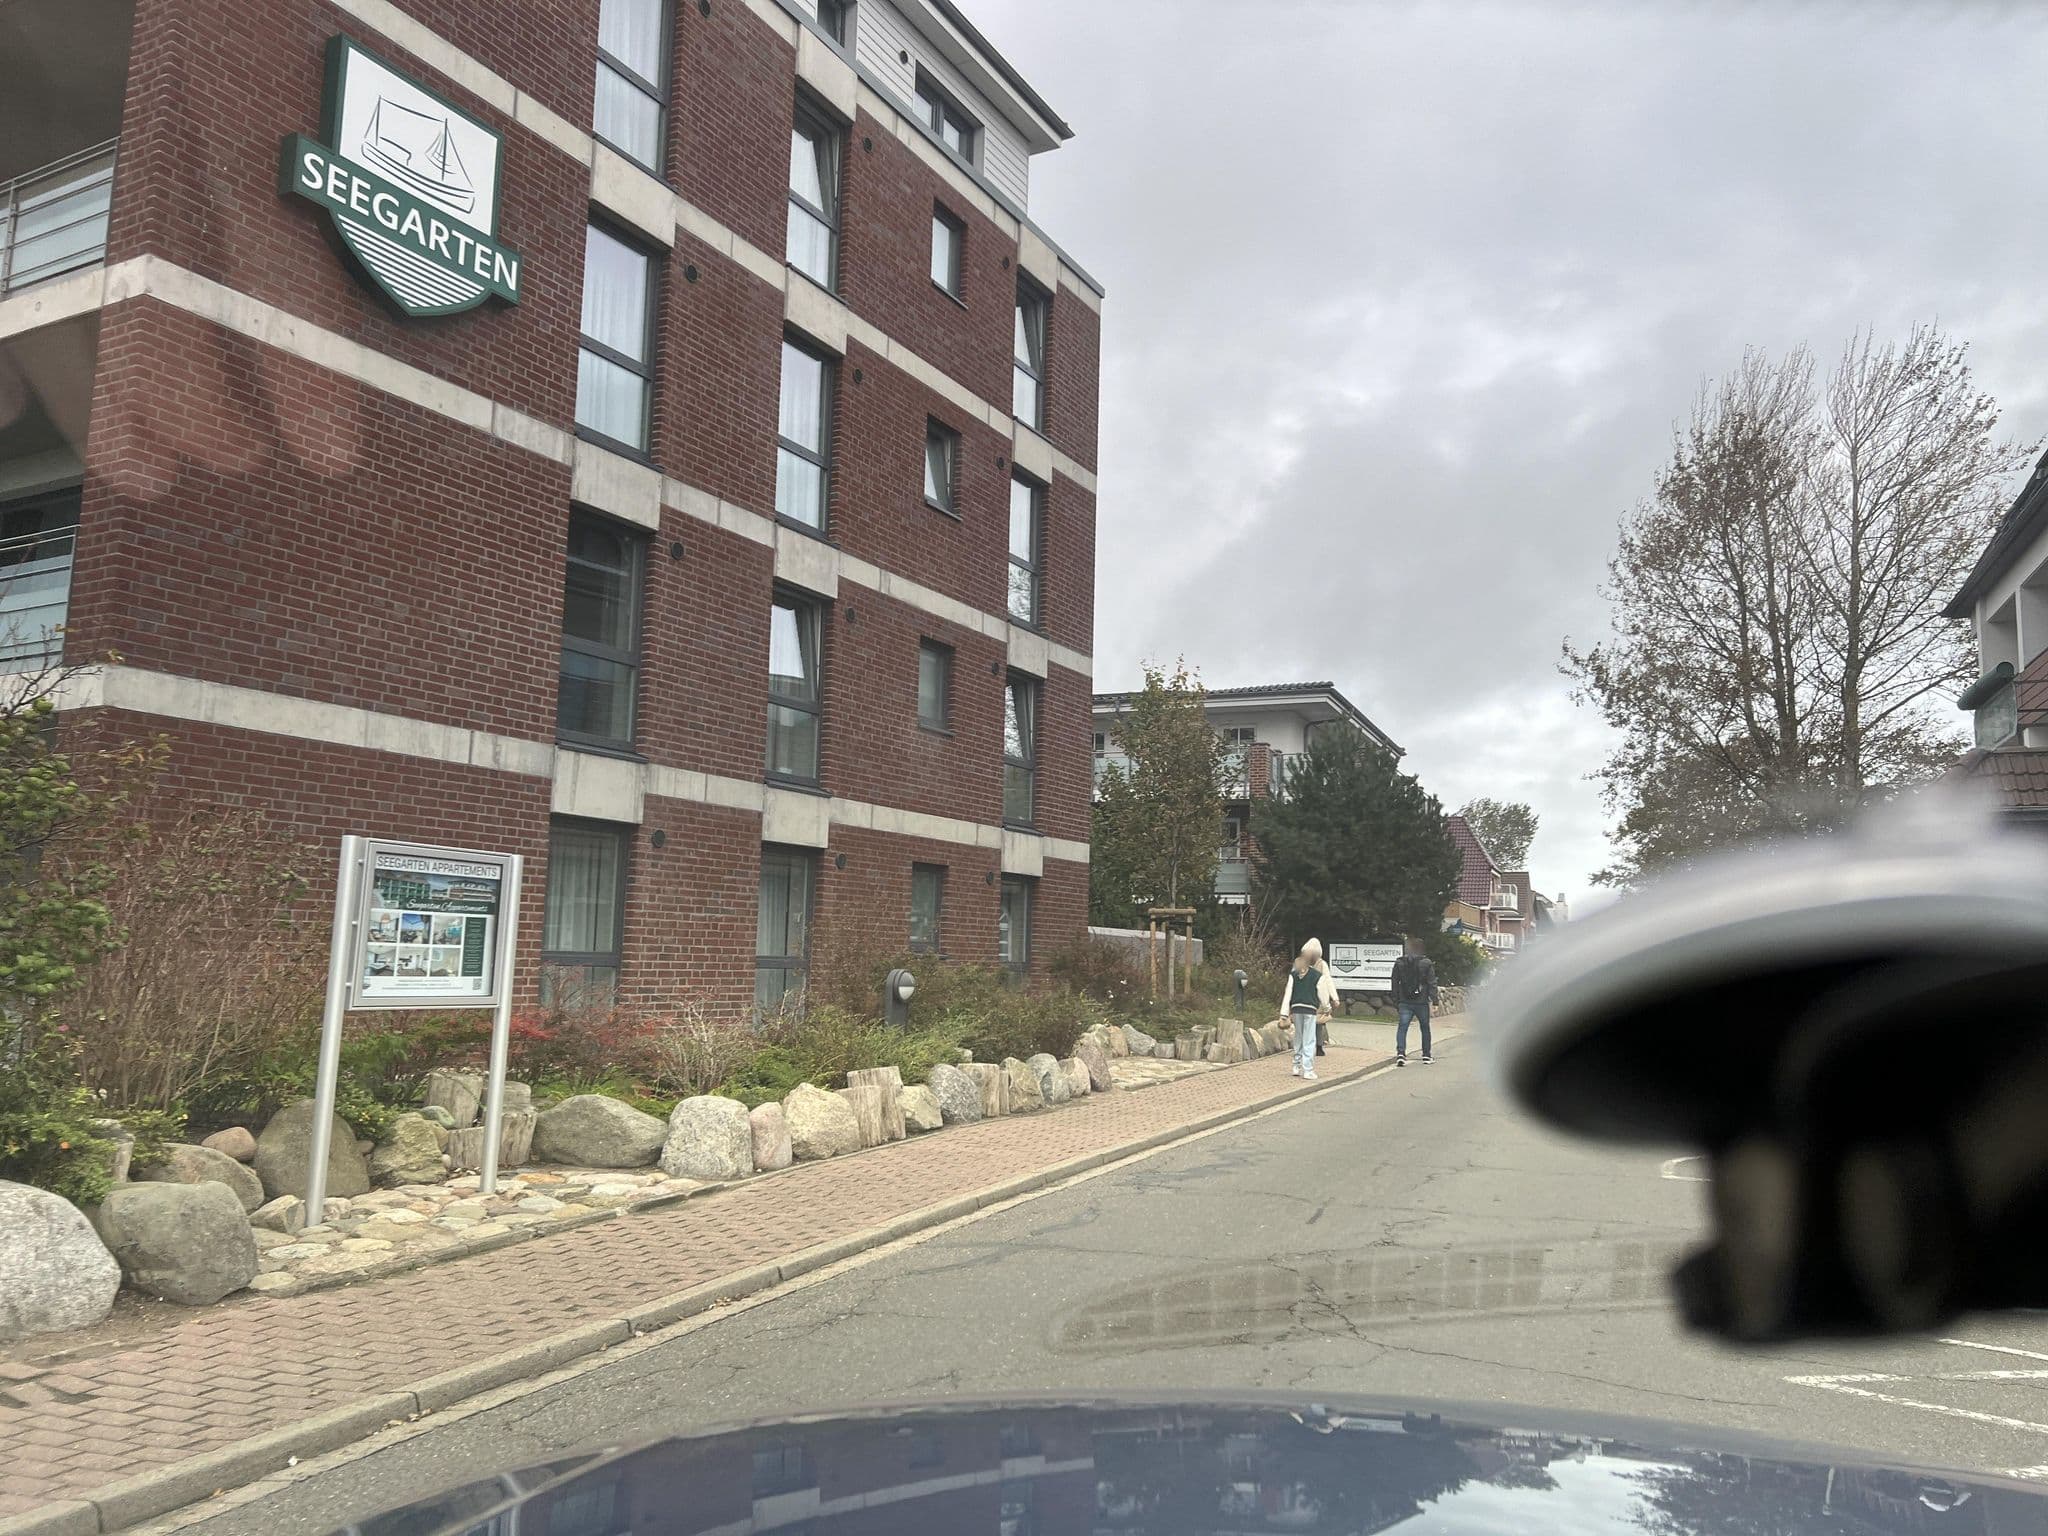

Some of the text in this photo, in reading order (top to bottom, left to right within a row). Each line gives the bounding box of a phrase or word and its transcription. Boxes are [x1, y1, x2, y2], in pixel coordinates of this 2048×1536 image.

[301, 152, 518, 291] SEEGARTEN
[376, 855, 498, 877] SEEGARTEN APPARTEMENTS
[1363, 949, 1401, 957] SEEGARTEN
